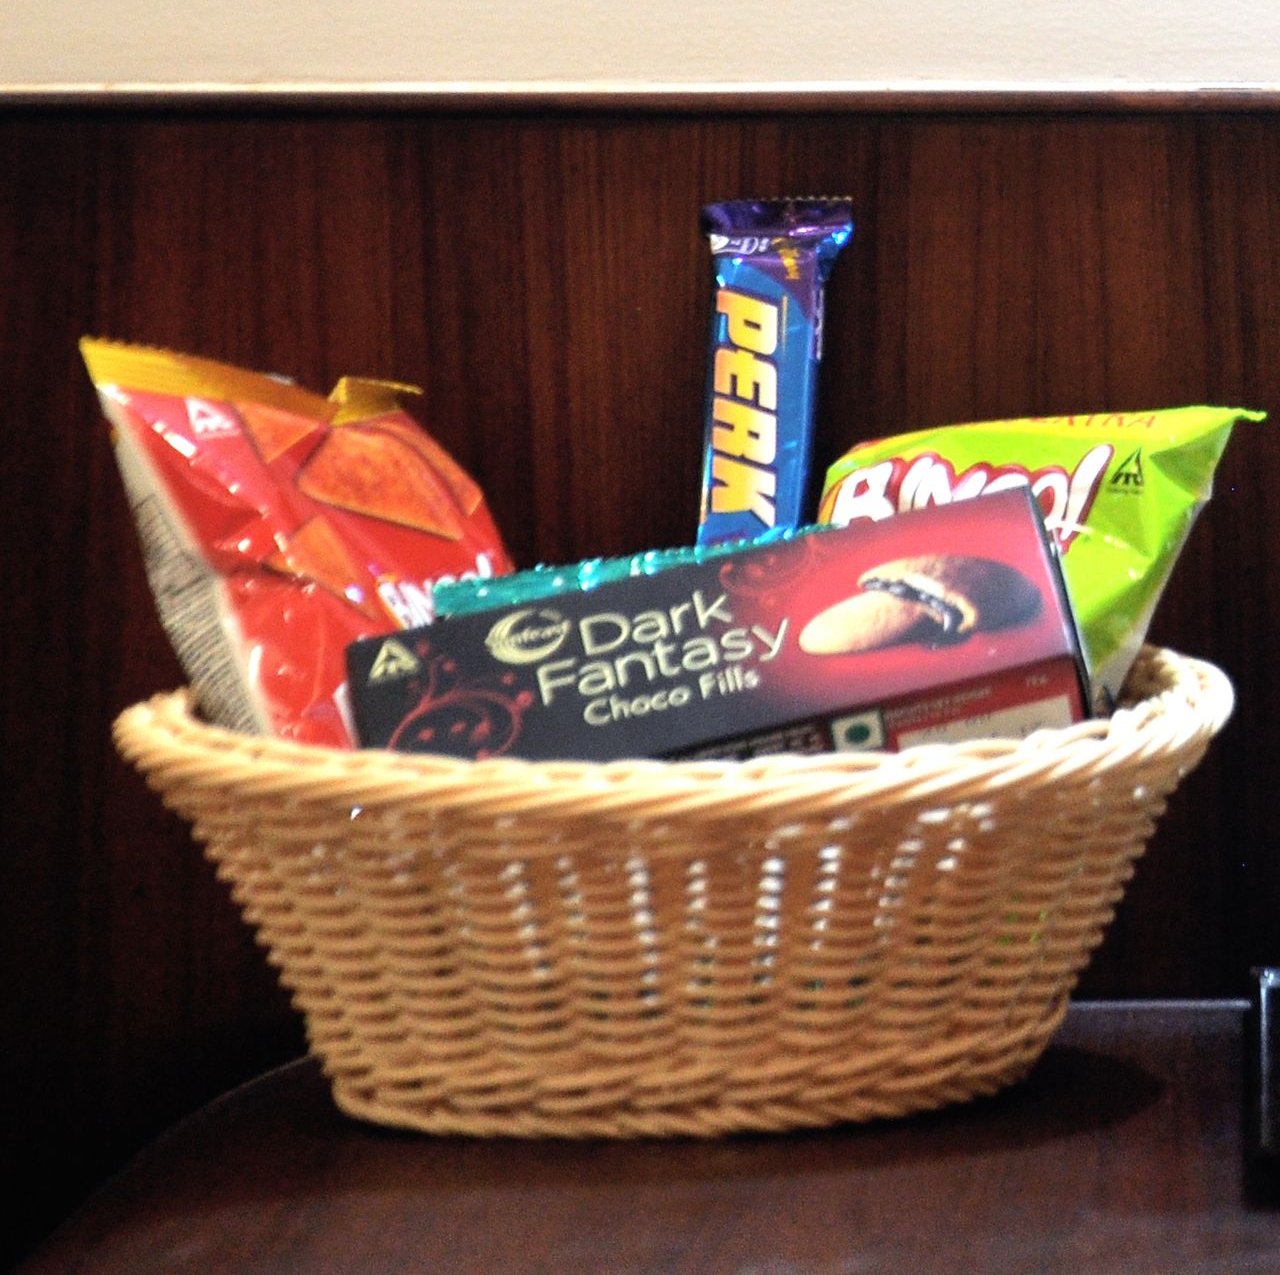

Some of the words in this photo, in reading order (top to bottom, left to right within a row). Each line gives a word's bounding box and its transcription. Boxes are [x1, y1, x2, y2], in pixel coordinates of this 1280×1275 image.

[711, 289, 779, 528] PERK
[579, 589, 733, 656] Dark
[536, 618, 789, 707] Fantasy
[583, 685, 691, 726] Choco
[699, 664, 761, 701] Fills
